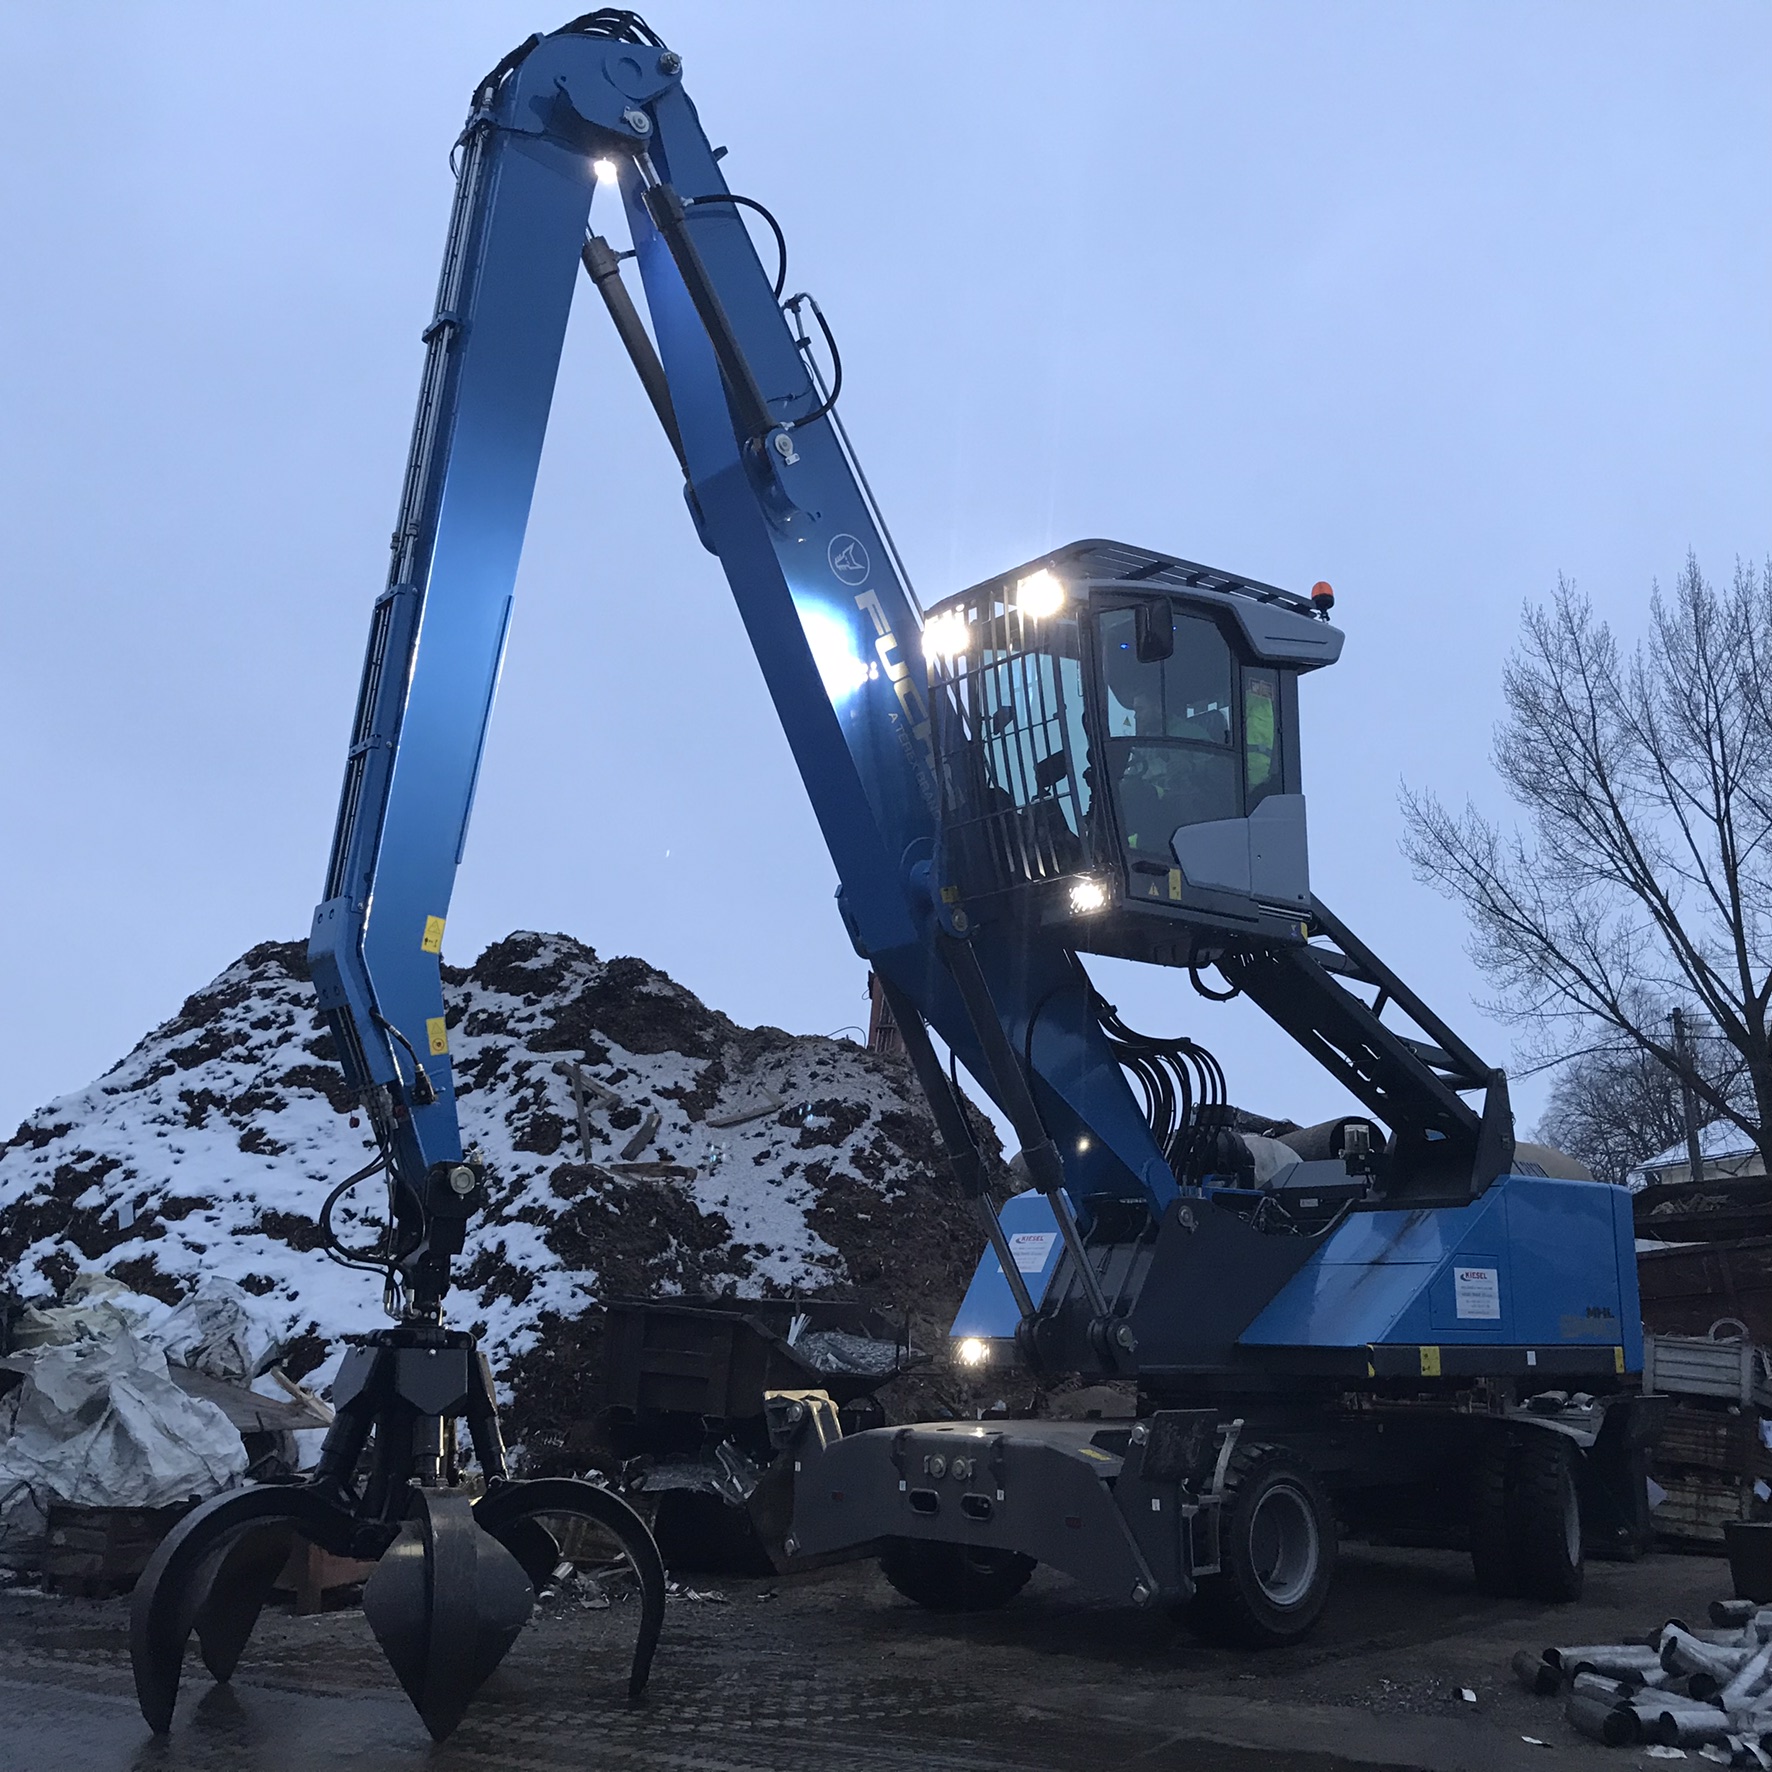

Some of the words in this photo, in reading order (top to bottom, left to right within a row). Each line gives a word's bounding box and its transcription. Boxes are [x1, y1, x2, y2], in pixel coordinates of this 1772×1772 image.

[888, 713, 898, 723] A
[895, 724, 920, 770] TEREX
[1464, 1271, 1488, 1280] KIESEL
